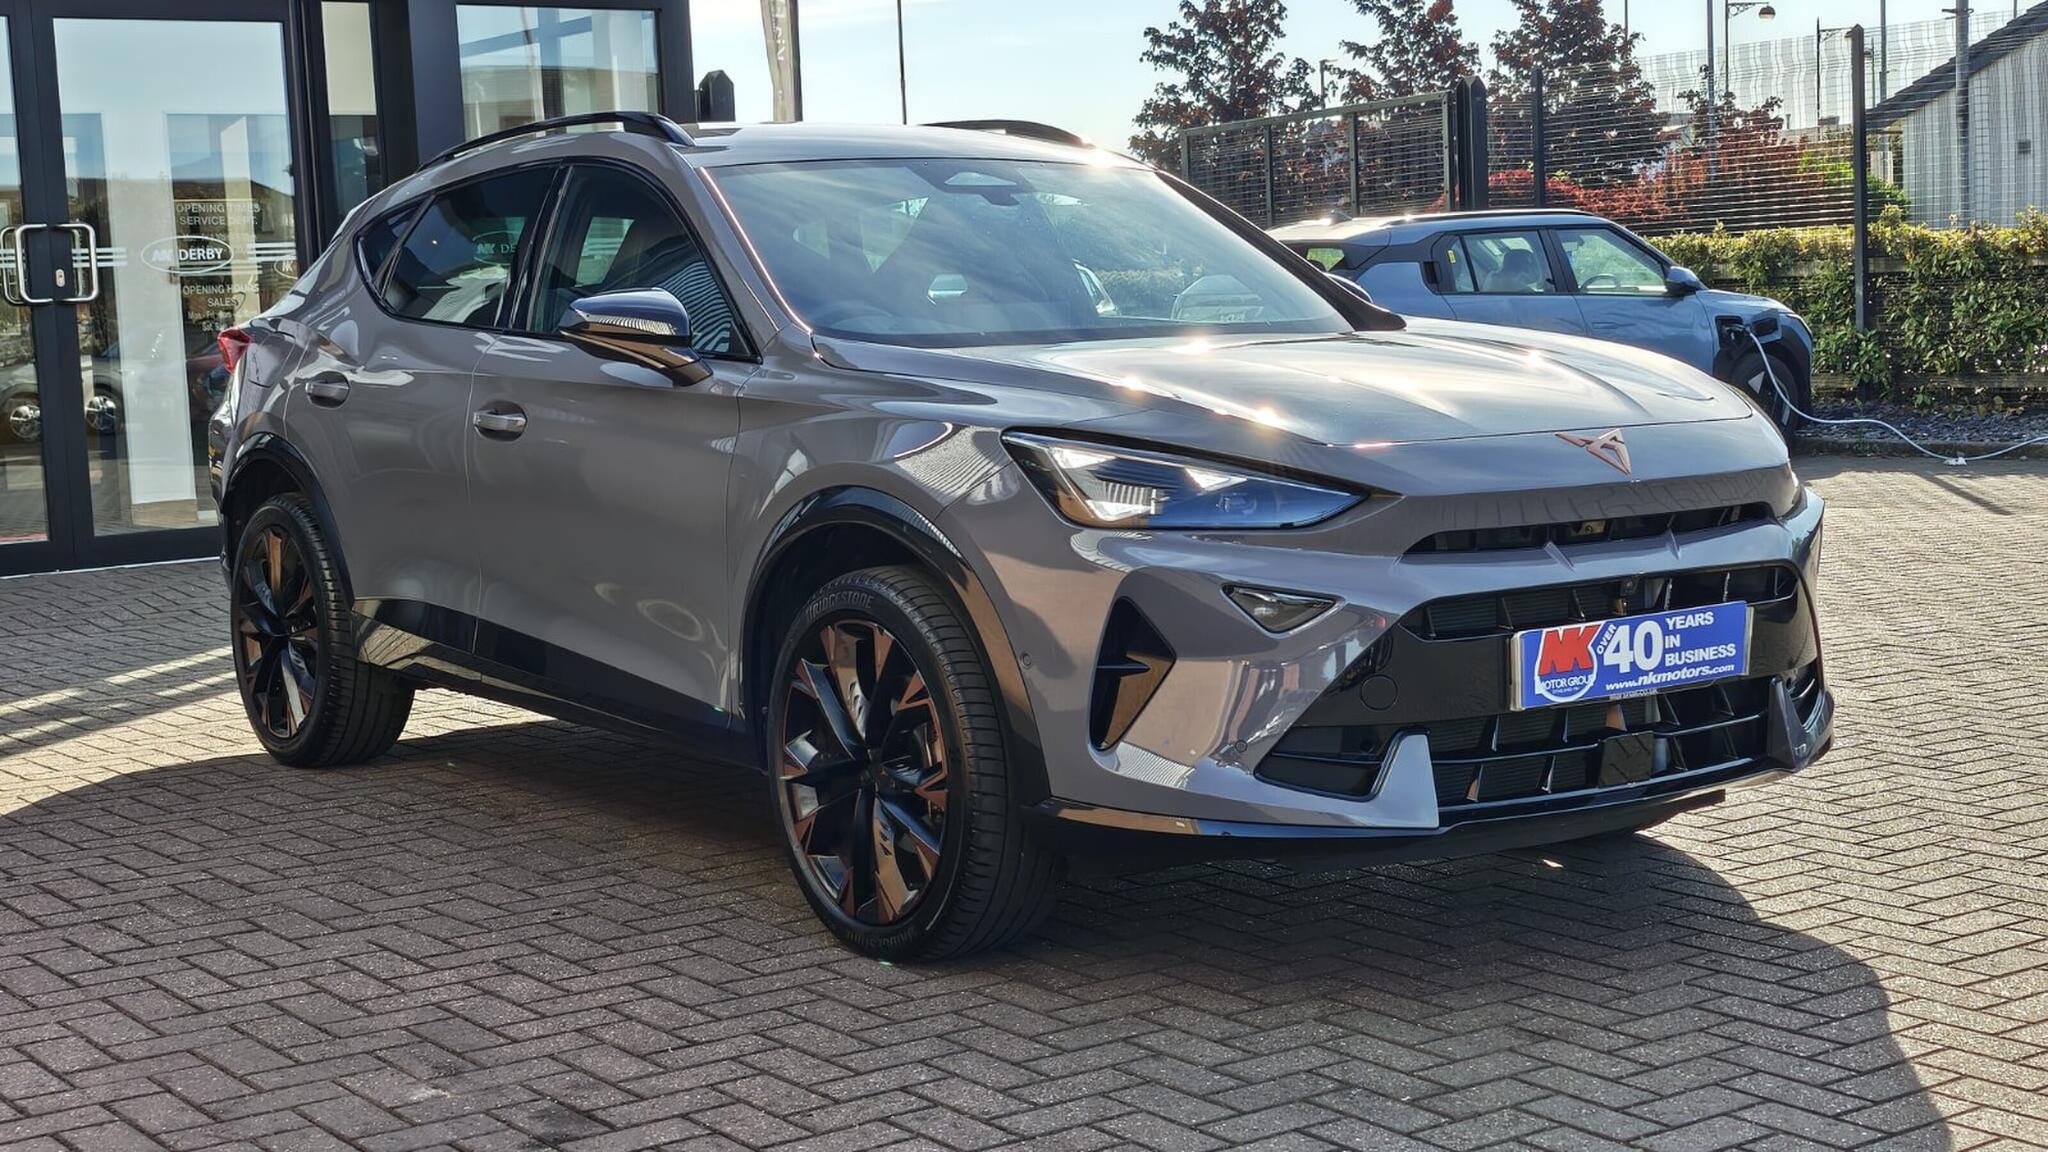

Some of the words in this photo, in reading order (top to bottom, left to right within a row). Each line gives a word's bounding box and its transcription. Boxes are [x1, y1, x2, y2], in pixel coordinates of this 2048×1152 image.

[176, 202, 225, 213] OPENING
[179, 216, 226, 226] SERVICE
[178, 248, 224, 261] DERBY
[182, 285, 225, 296] OPENING
[207, 297, 238, 308] SALES
[1665, 611, 1715, 631] YEARS
[1596, 624, 1617, 655] OVER
[1603, 620, 1664, 674] 40
[1664, 634, 1681, 649] IN
[1538, 624, 1601, 676] NK
[1664, 643, 1736, 667] BUSINESS
[1605, 663, 1735, 691] www.nkmotors.com
